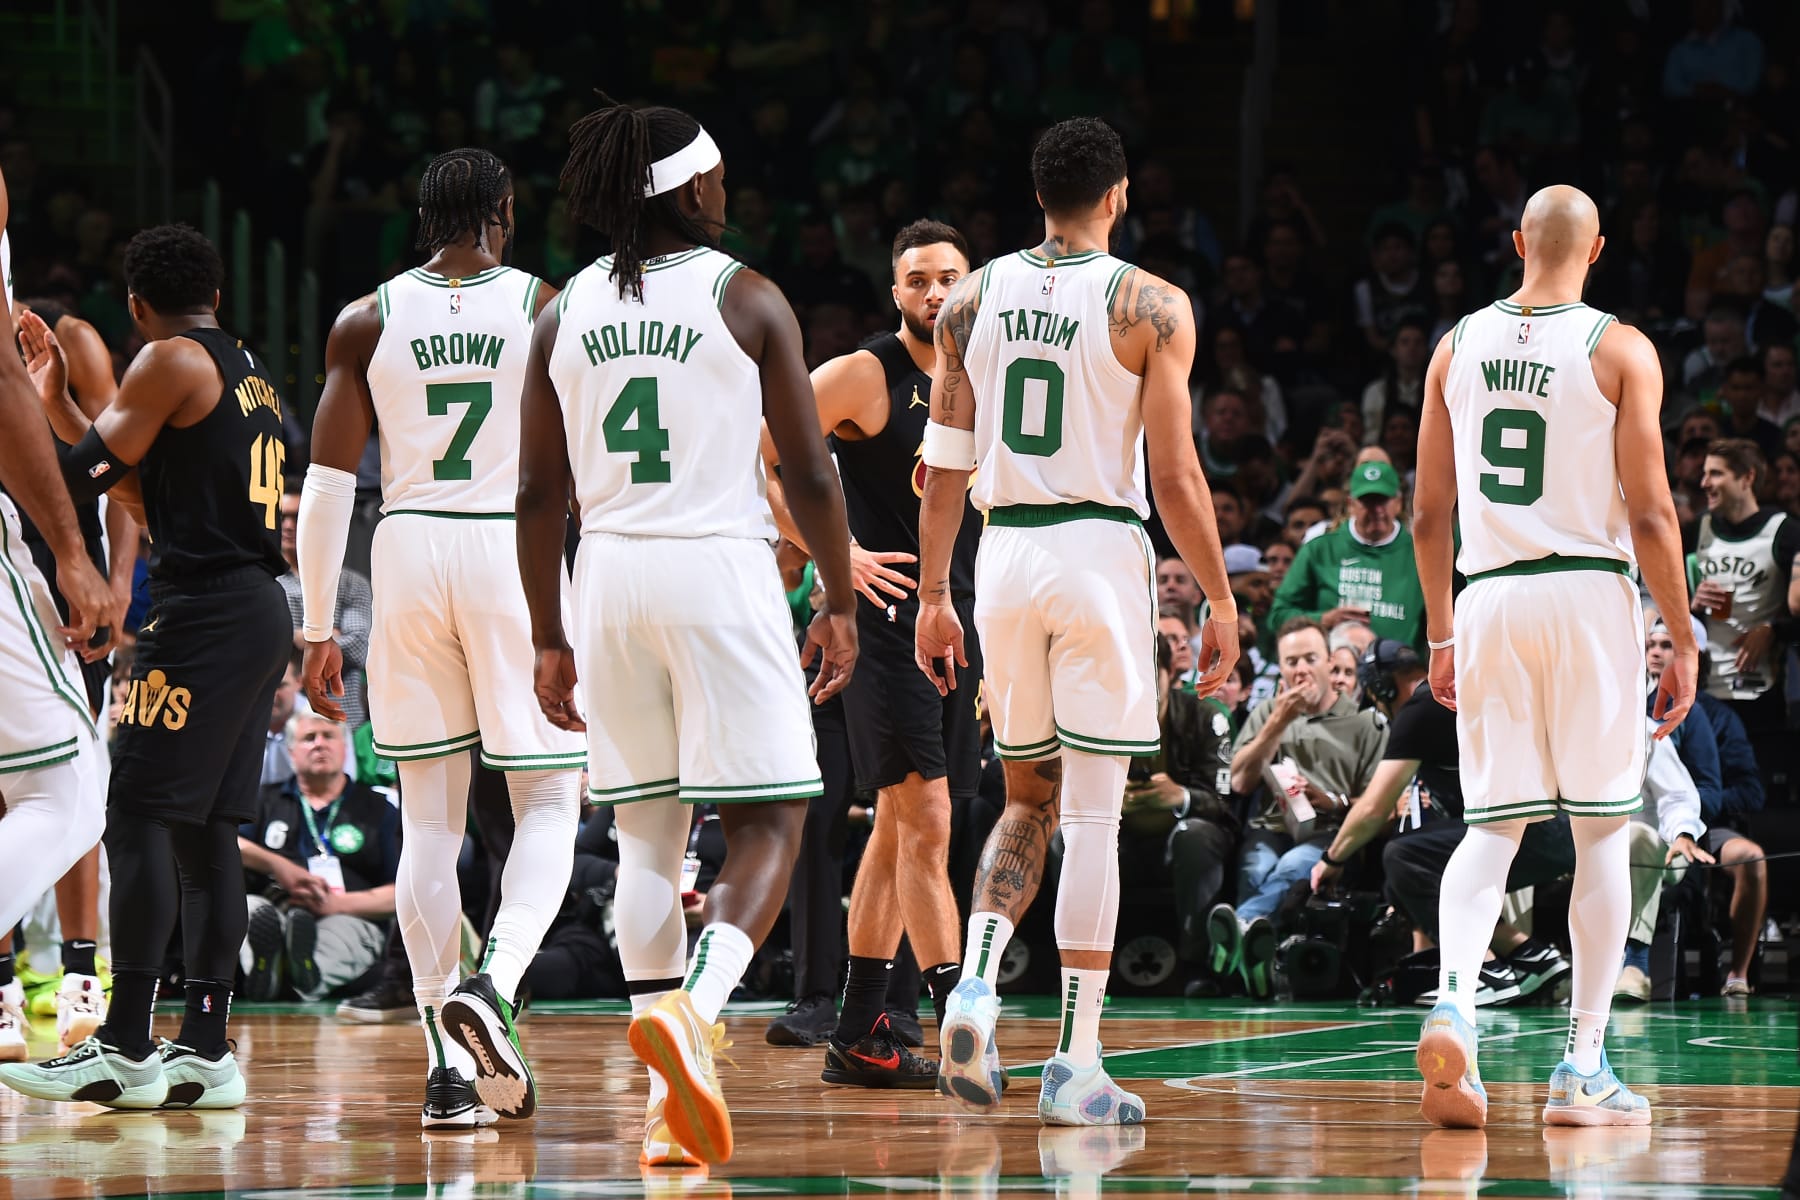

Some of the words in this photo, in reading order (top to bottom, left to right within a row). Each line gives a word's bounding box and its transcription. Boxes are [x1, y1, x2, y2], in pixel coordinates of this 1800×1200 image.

[410, 332, 505, 371] BROWN
[581, 320, 704, 367] HOLIDAY
[998, 308, 1080, 351] TATUM
[1480, 359, 1556, 398] WHITE
[602, 376, 671, 484] 4
[1002, 357, 1064, 457] 0
[425, 381, 492, 481] 7
[249, 431, 285, 530] 45
[1479, 408, 1546, 506] 9
[1699, 556, 1769, 588] OSTON
[264, 820, 289, 849] 6
